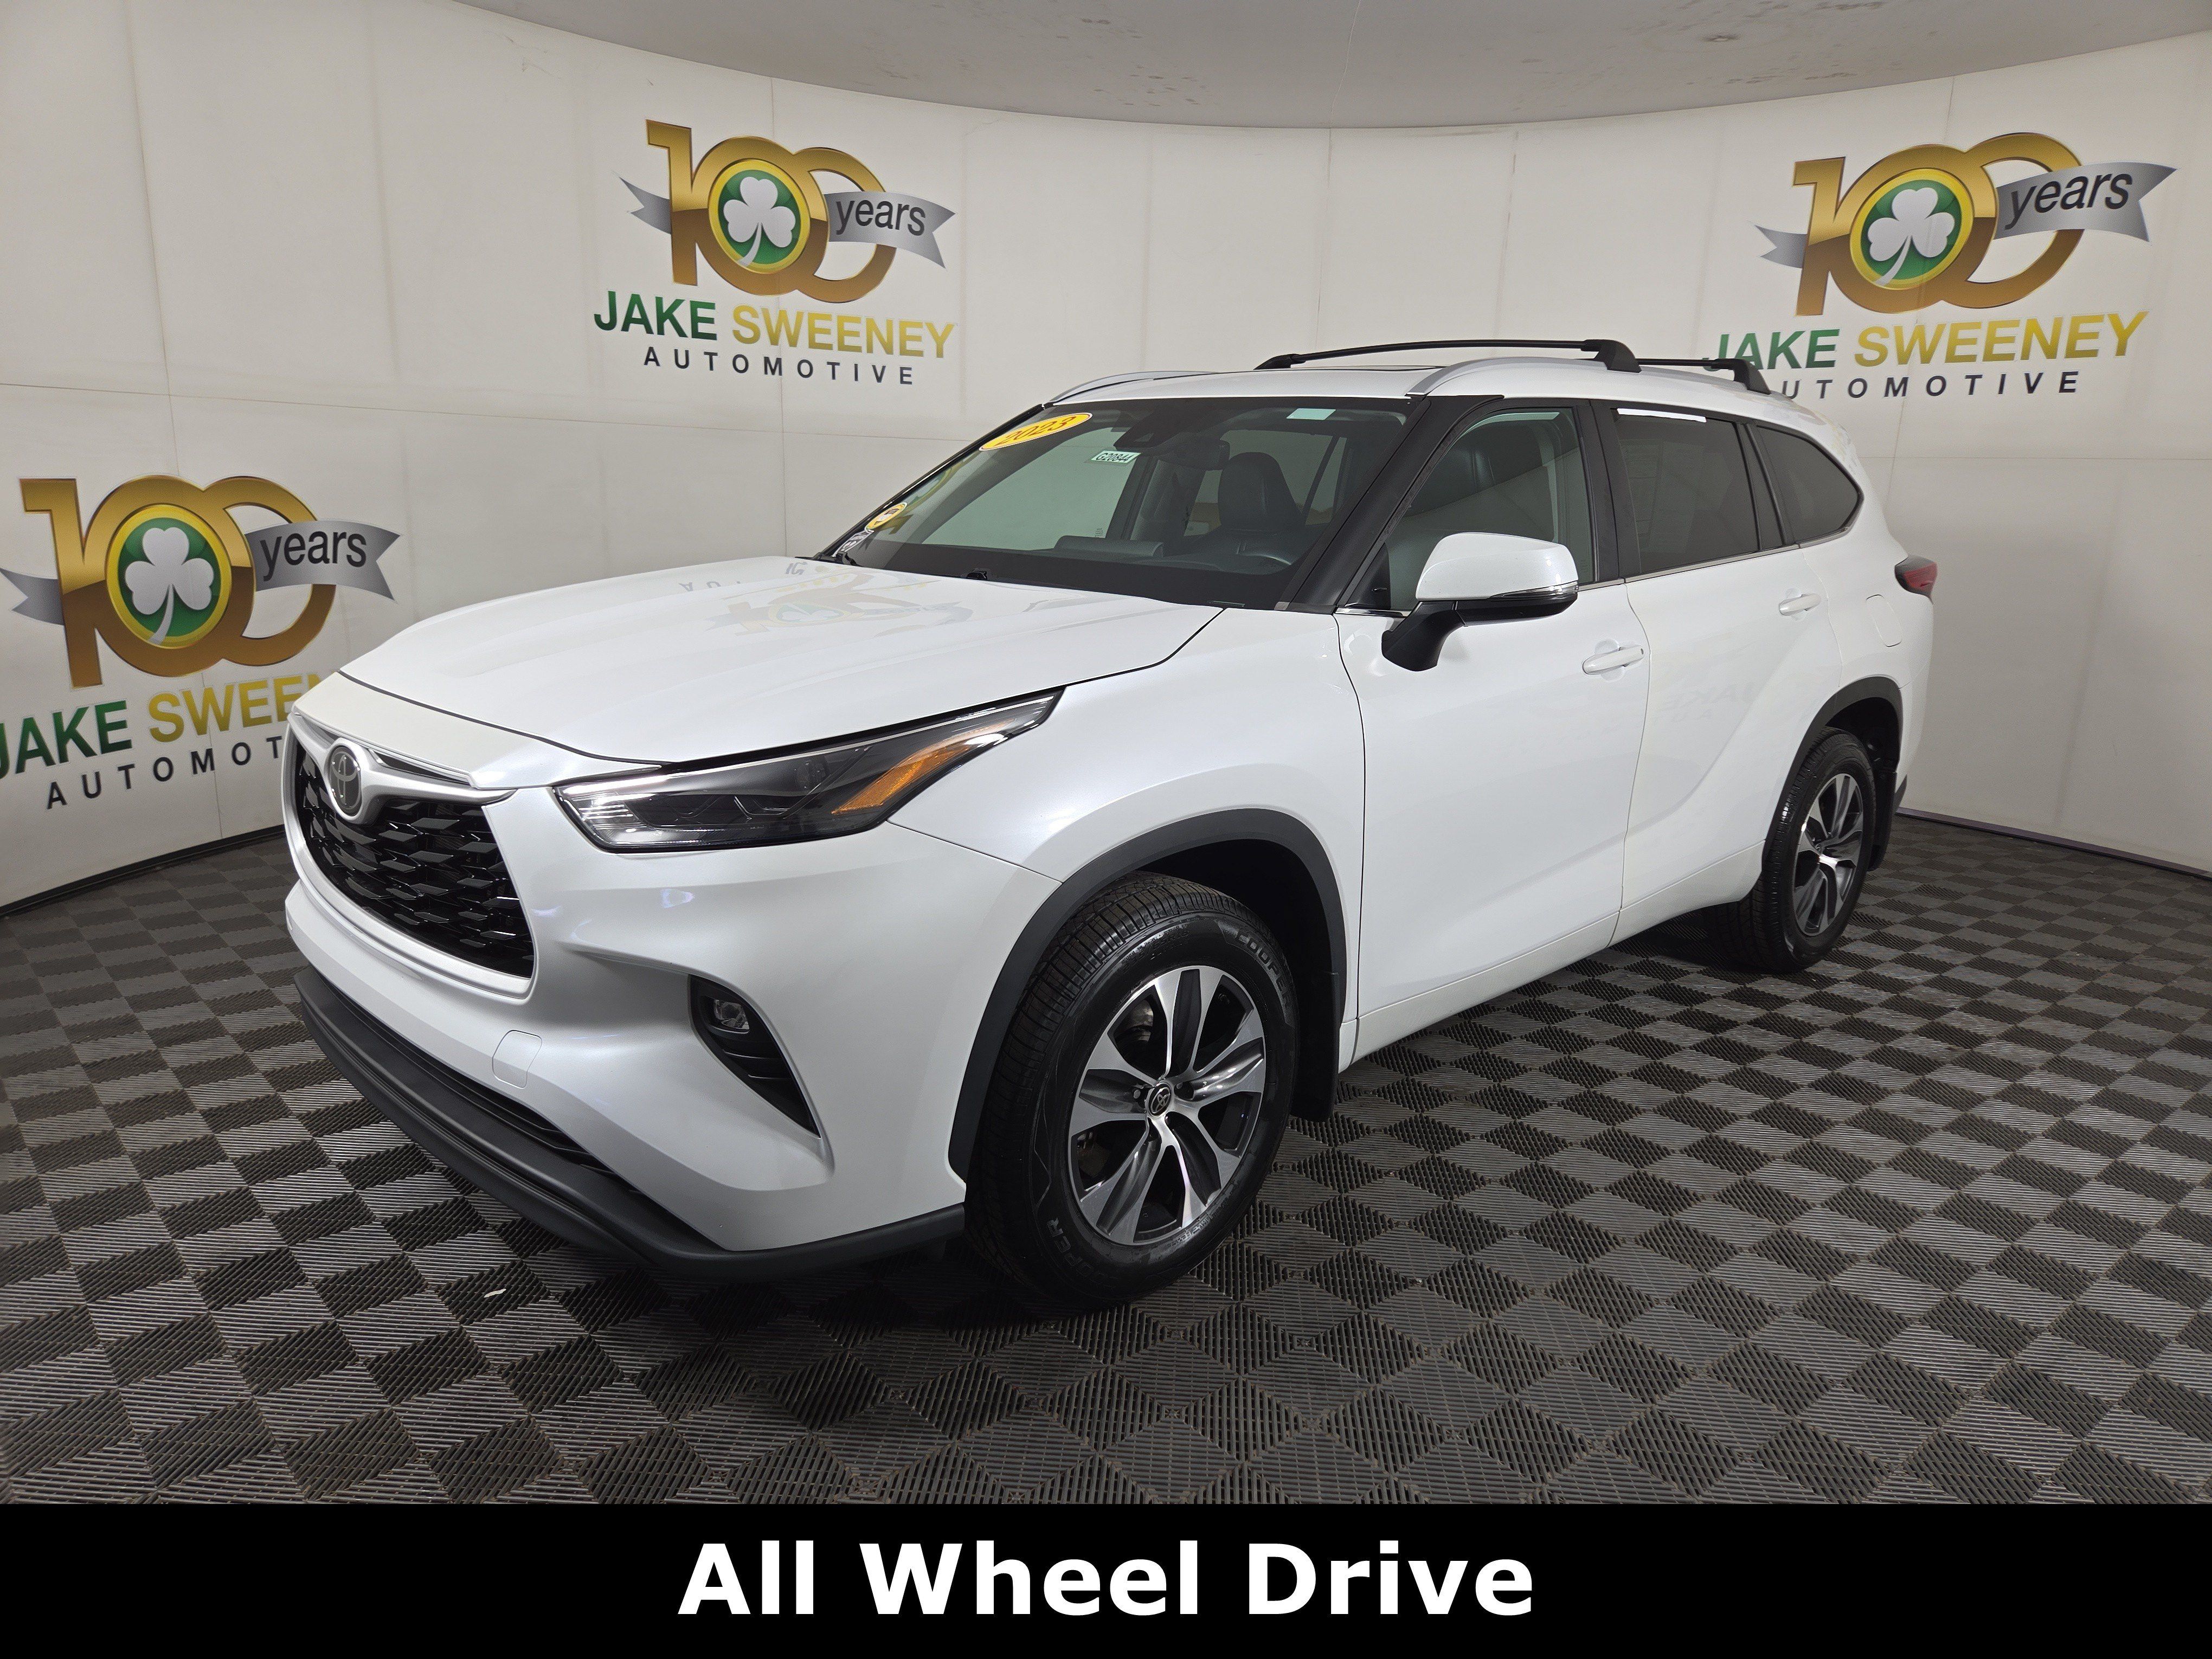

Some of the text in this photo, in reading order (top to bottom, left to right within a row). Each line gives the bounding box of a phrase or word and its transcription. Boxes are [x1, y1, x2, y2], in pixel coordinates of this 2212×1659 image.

[646, 119, 926, 304] 100 years
[1792, 132, 2133, 316] 100 years
[594, 290, 955, 359] JAKE SWEENEY
[1854, 311, 2149, 368] SWEENEY
[644, 346, 913, 385] AUTOMOTIVE
[1782, 370, 2079, 400] UTOMOTIVE
[993, 416, 1077, 447] 2023
[1096, 453, 1135, 462] G20844
[20, 474, 367, 689] 100 years
[149, 673, 320, 742] SWEE
[47, 735, 282, 810] AUTOMOT
[1234, 928, 1294, 1011] COOPER
